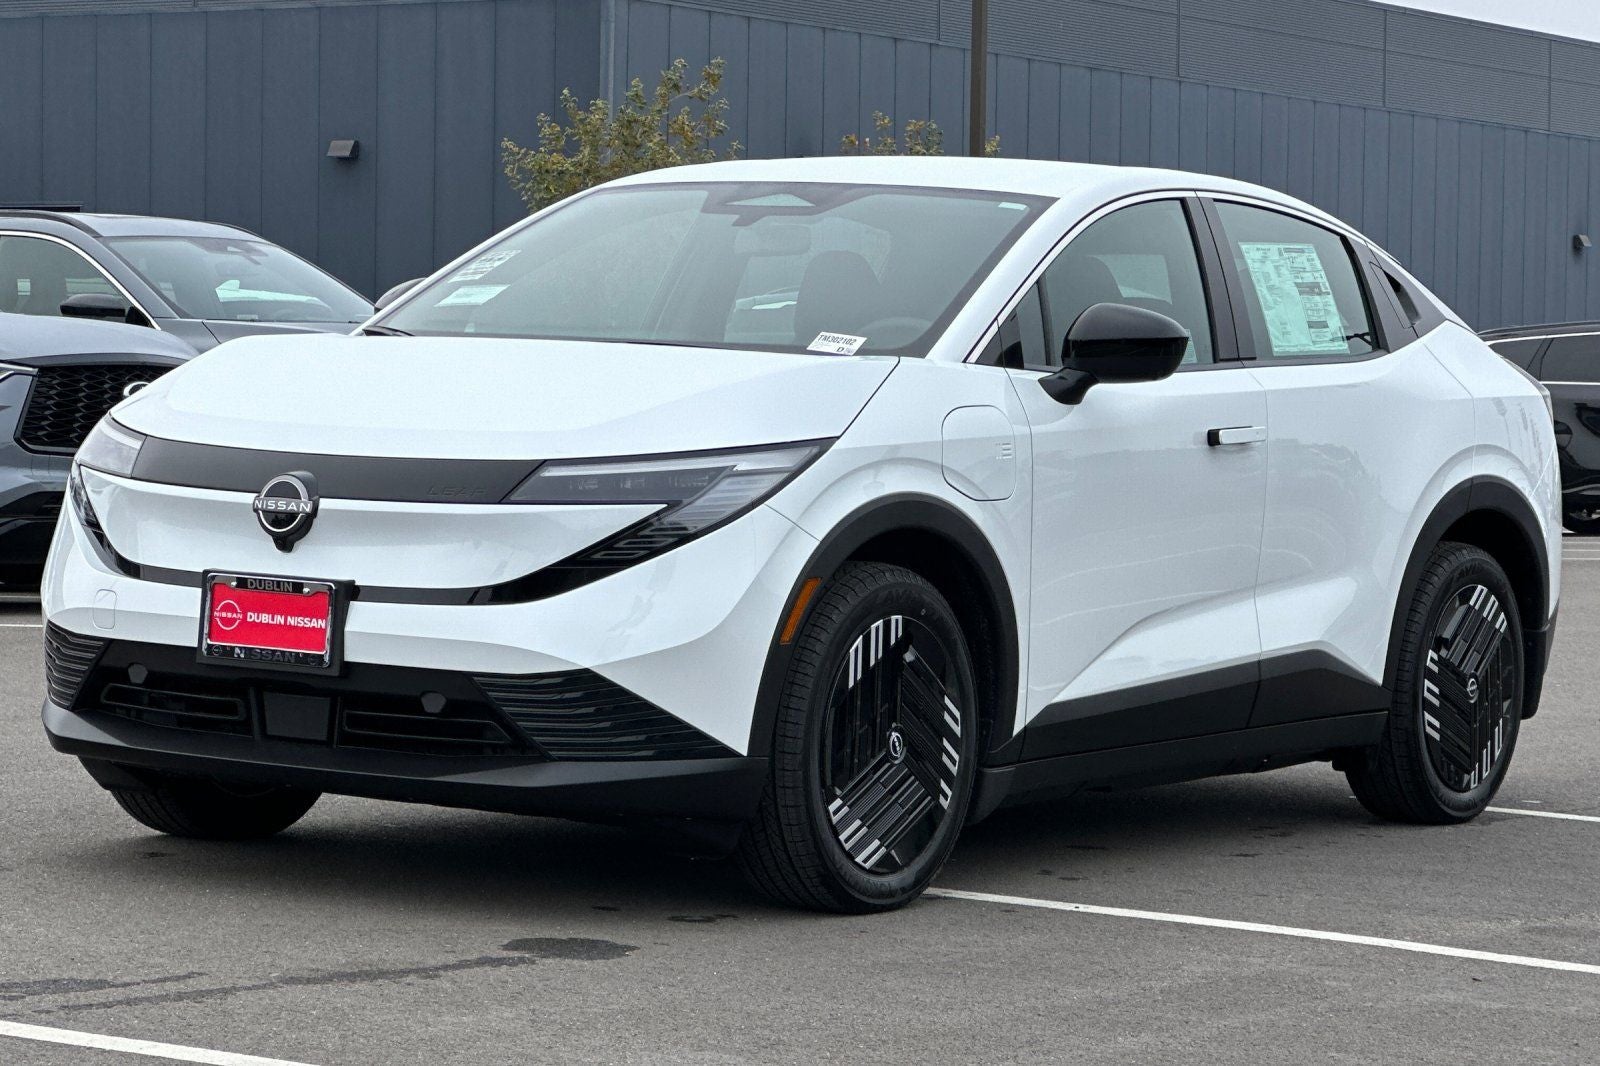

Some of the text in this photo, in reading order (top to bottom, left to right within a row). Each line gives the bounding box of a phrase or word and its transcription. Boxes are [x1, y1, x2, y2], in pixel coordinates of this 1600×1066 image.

[818, 334, 857, 345] TM302102
[254, 499, 312, 513] NISSAN
[247, 579, 293, 592] DUBLIN
[214, 611, 243, 619] NISSAN
[247, 612, 326, 629] DUBLIN NISSAN
[233, 646, 295, 663] NSSAN
